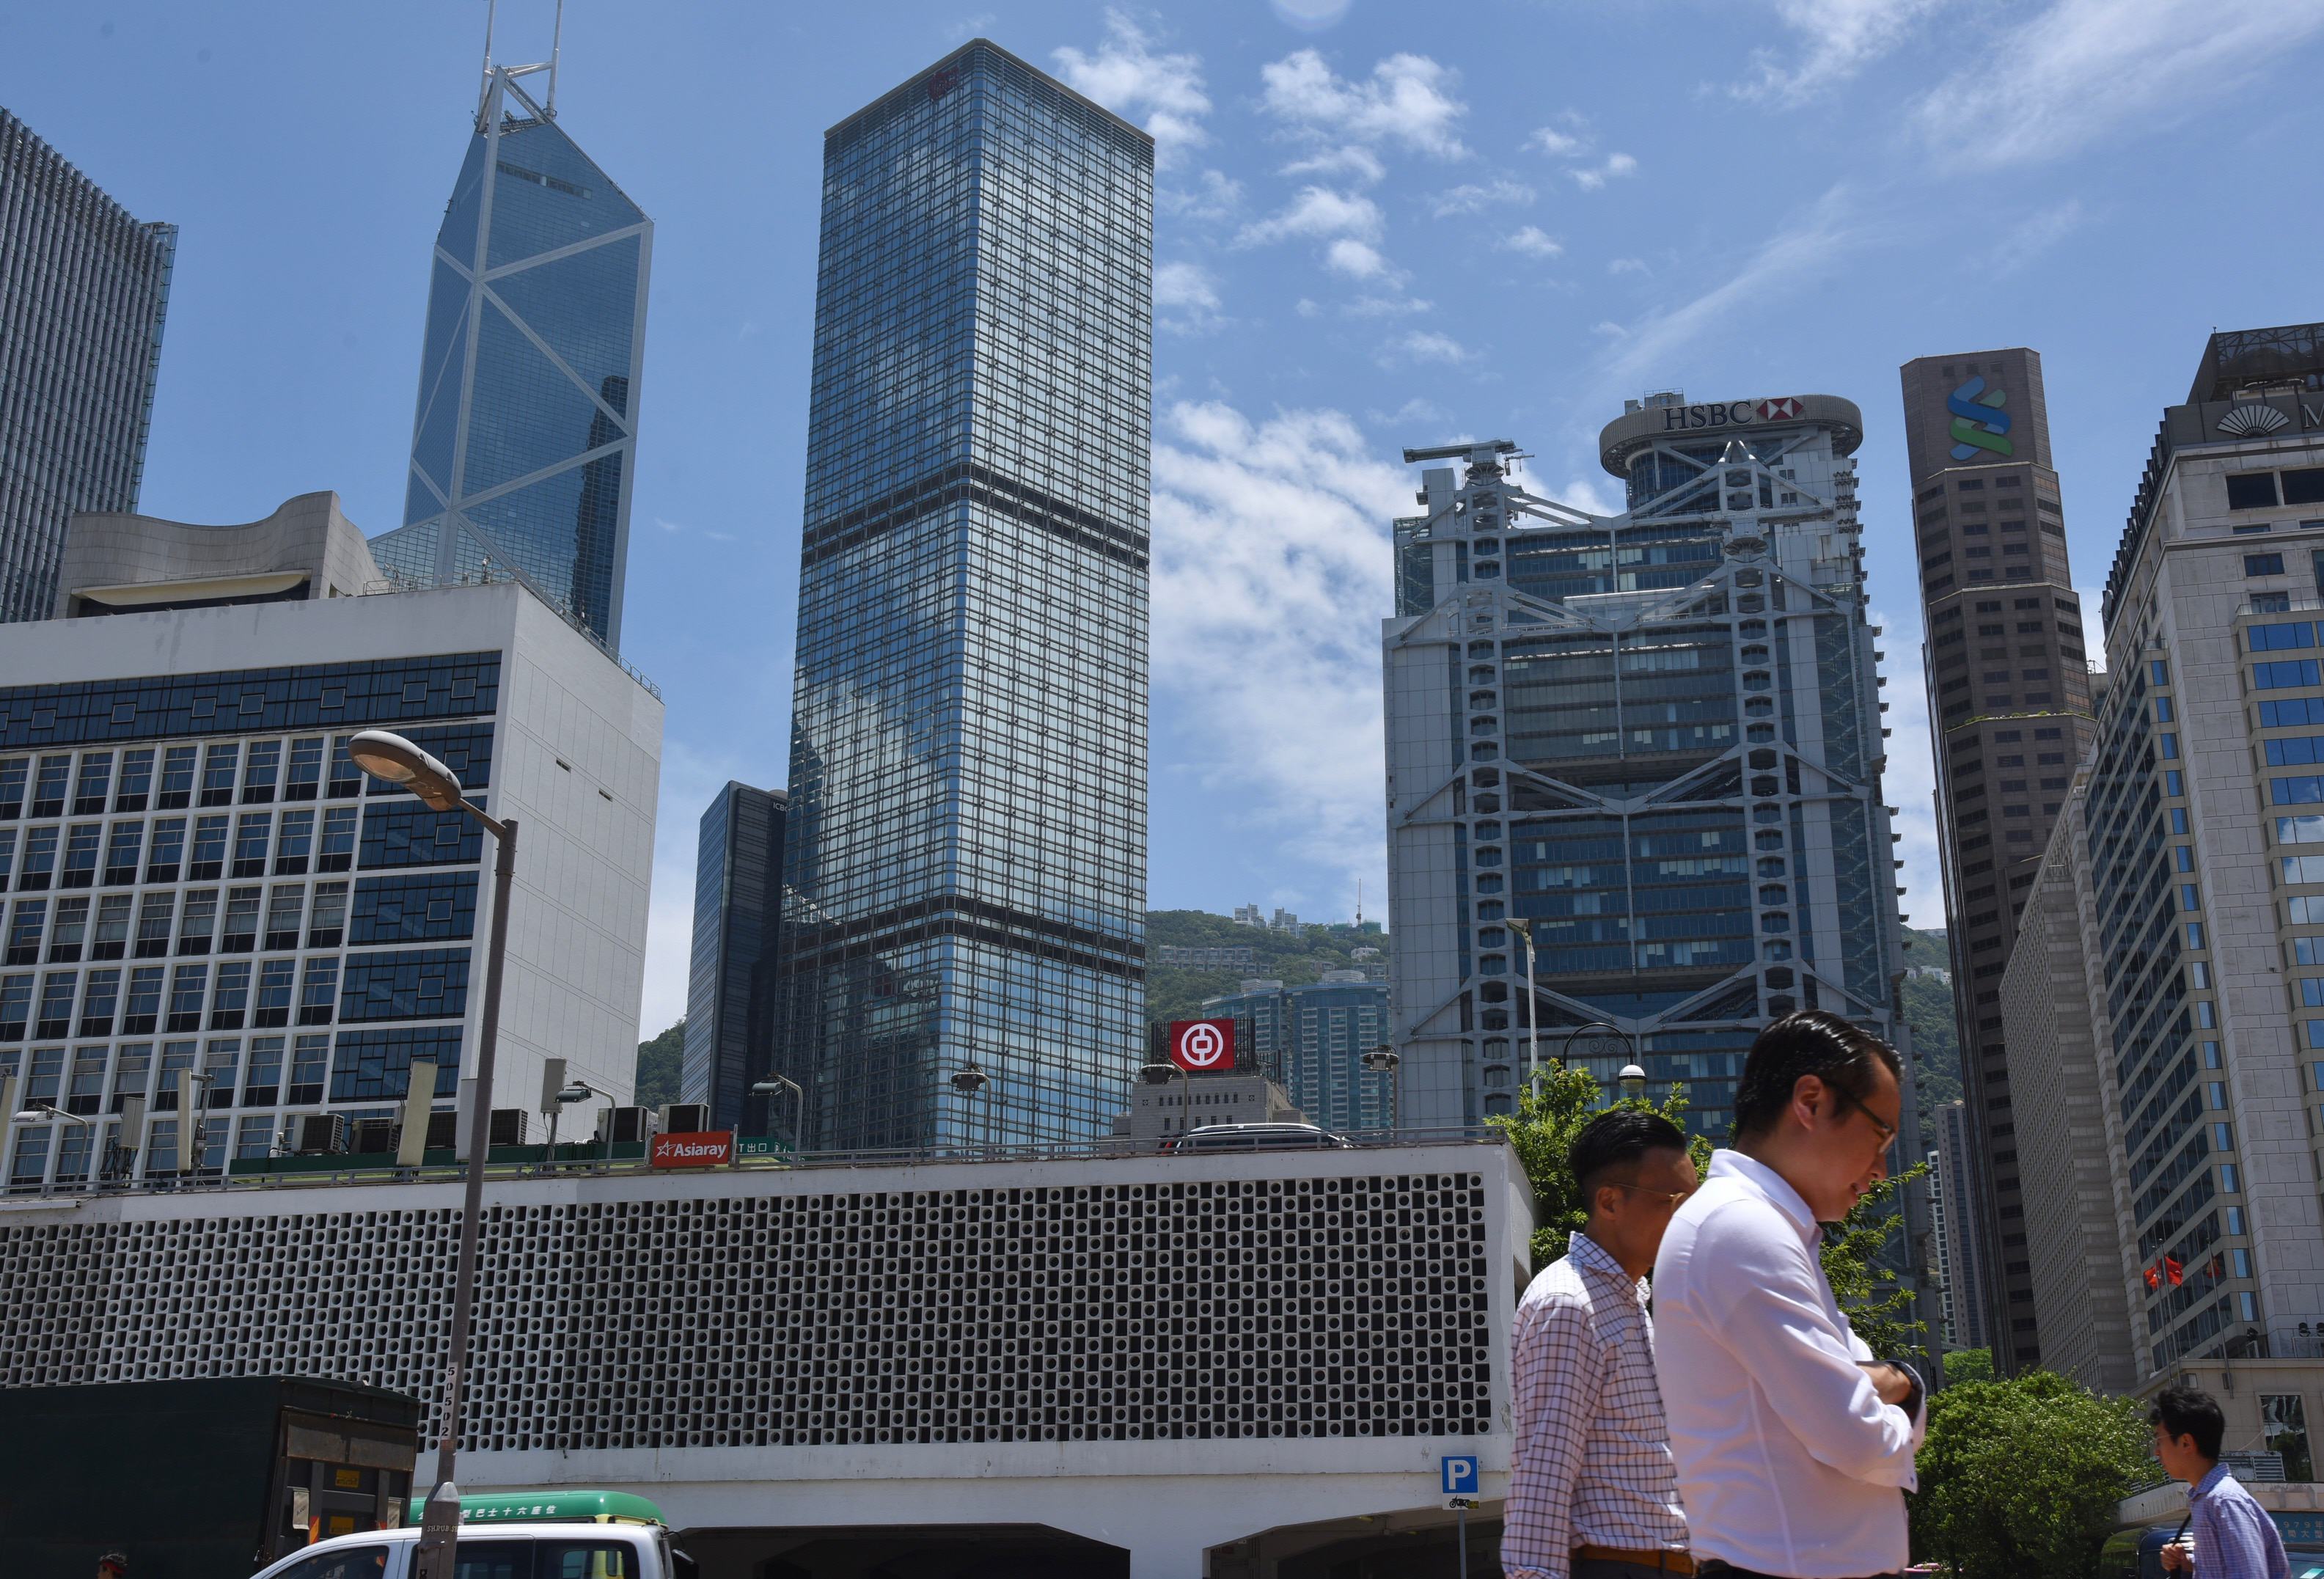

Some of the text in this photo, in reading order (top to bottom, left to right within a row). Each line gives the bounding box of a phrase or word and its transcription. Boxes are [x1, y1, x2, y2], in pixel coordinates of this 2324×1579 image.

[1662, 400, 1753, 431] HSBC
[673, 1142, 727, 1159] Asiaray
[747, 1143, 767, 1153] 出口
[1448, 1459, 1471, 1490] P
